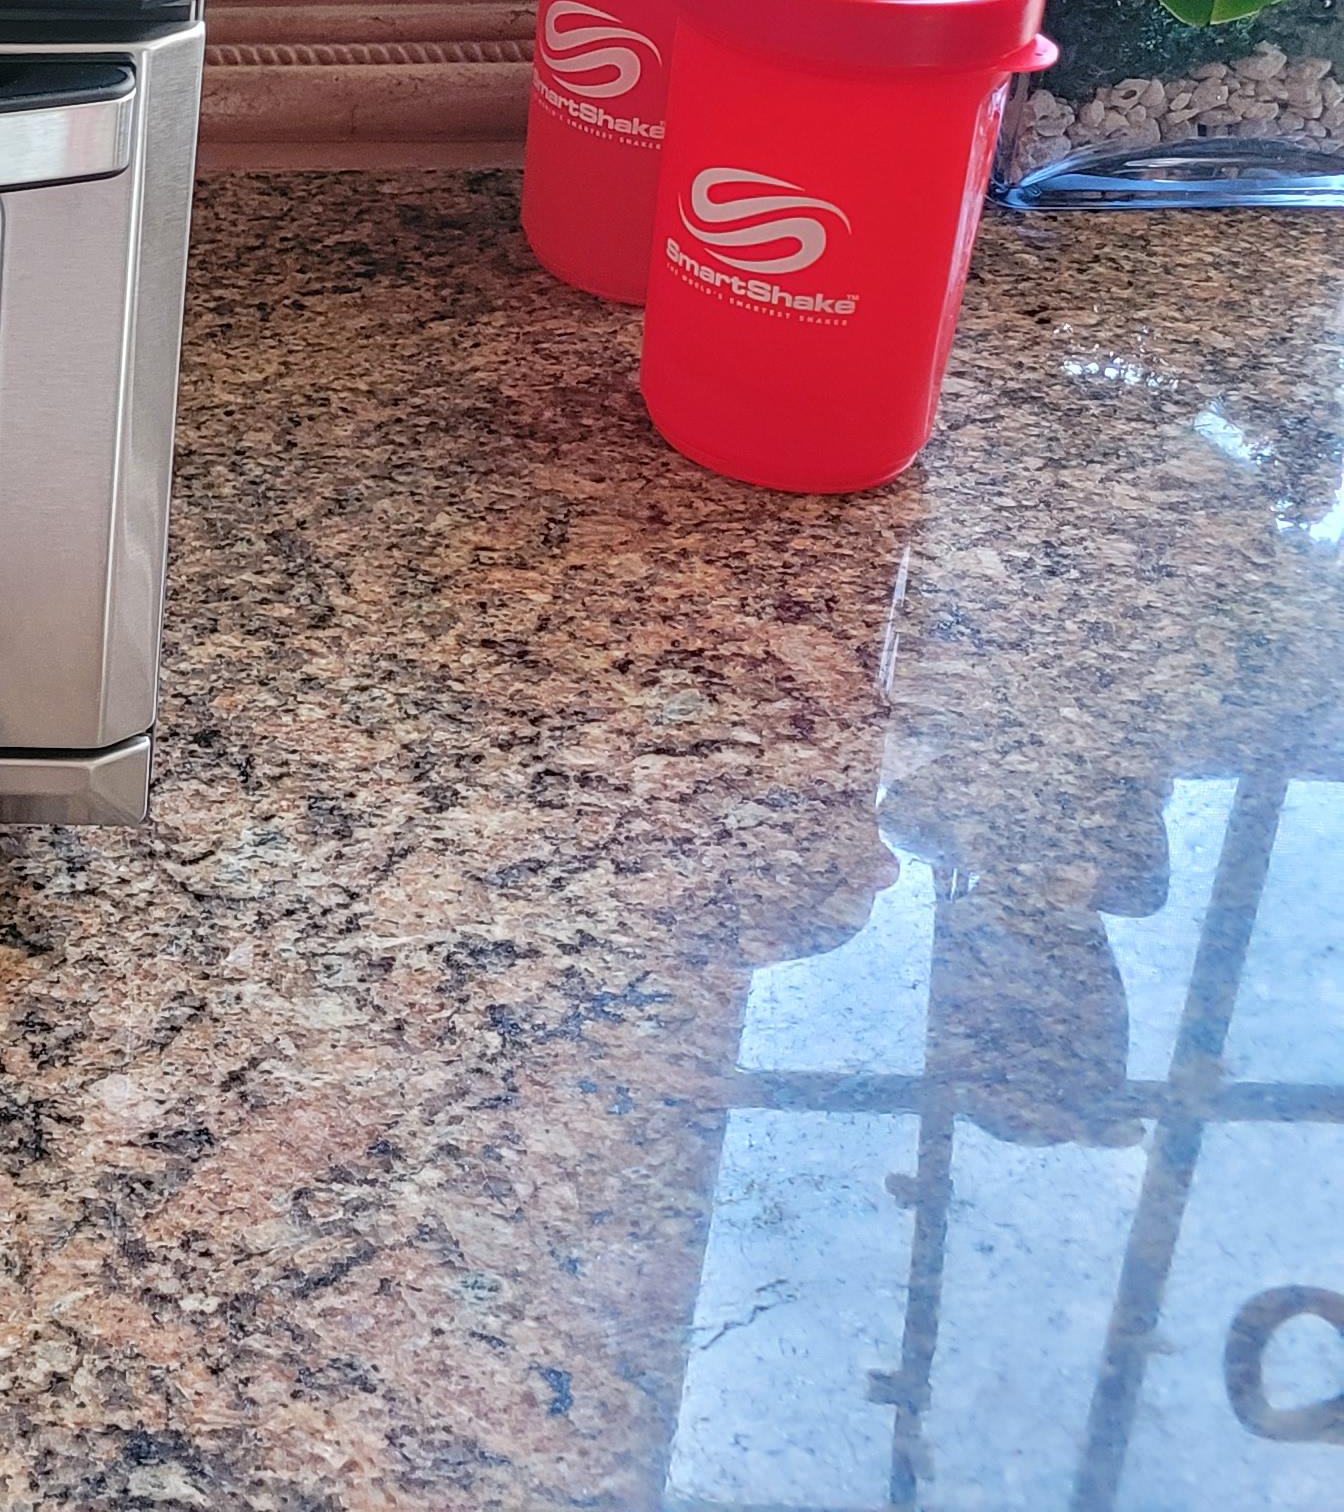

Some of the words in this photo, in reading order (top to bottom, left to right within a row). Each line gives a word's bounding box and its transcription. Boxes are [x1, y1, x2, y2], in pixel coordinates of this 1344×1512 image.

[532, 72, 665, 139] martShake
[666, 237, 856, 316] SmartShake
[729, 297, 791, 320] SMARTEST
[799, 314, 848, 327] SHAKER
